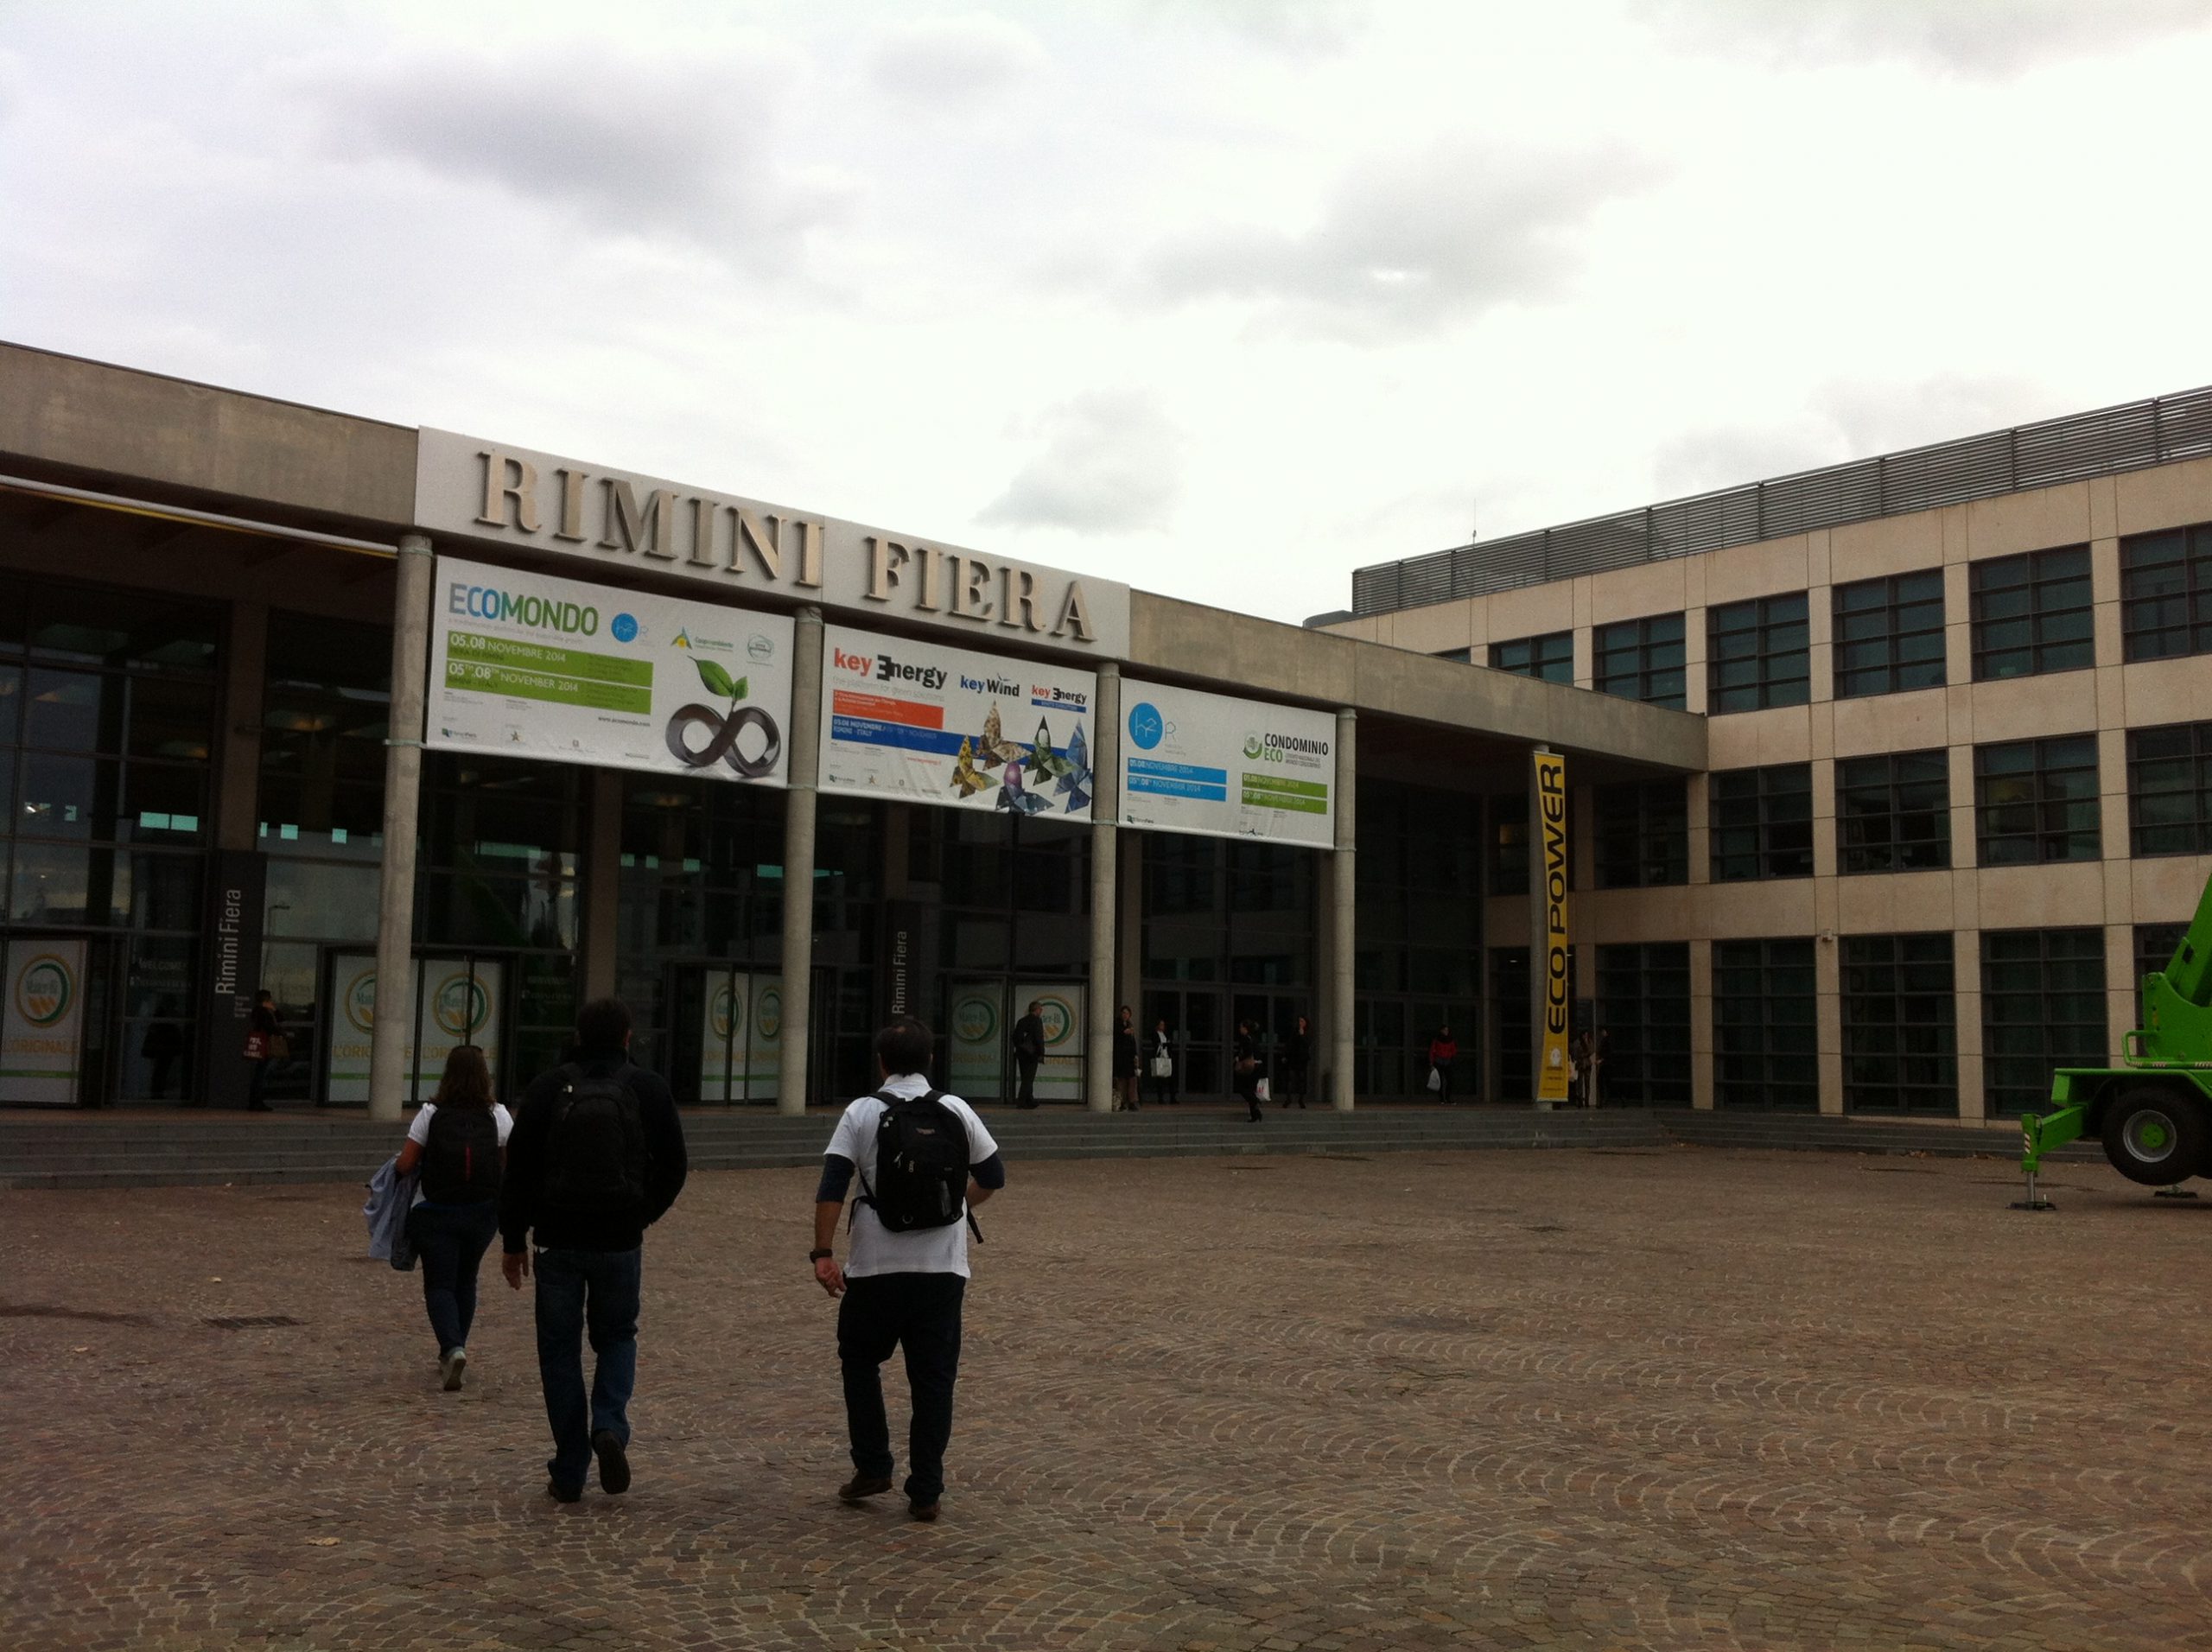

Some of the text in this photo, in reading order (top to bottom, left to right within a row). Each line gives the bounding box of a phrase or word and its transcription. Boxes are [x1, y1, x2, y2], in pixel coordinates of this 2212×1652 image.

[475, 451, 1096, 642] RIMINI FIERA
[448, 582, 599, 636] ECOMONDO
[487, 642, 543, 659] NOVEMBRE
[545, 651, 567, 663] 2014
[834, 647, 873, 677] key
[500, 671, 555, 690] NOVEMBER
[557, 681, 579, 692] 2014
[1031, 684, 1051, 699] key
[1264, 748, 1283, 763] ECO
[1265, 733, 1329, 756] CONDOMINIO
[1541, 763, 1566, 1034] ECO POWER
[215, 889, 242, 994] Rimini Fiera
[891, 931, 908, 1015] Rimini Fiera
